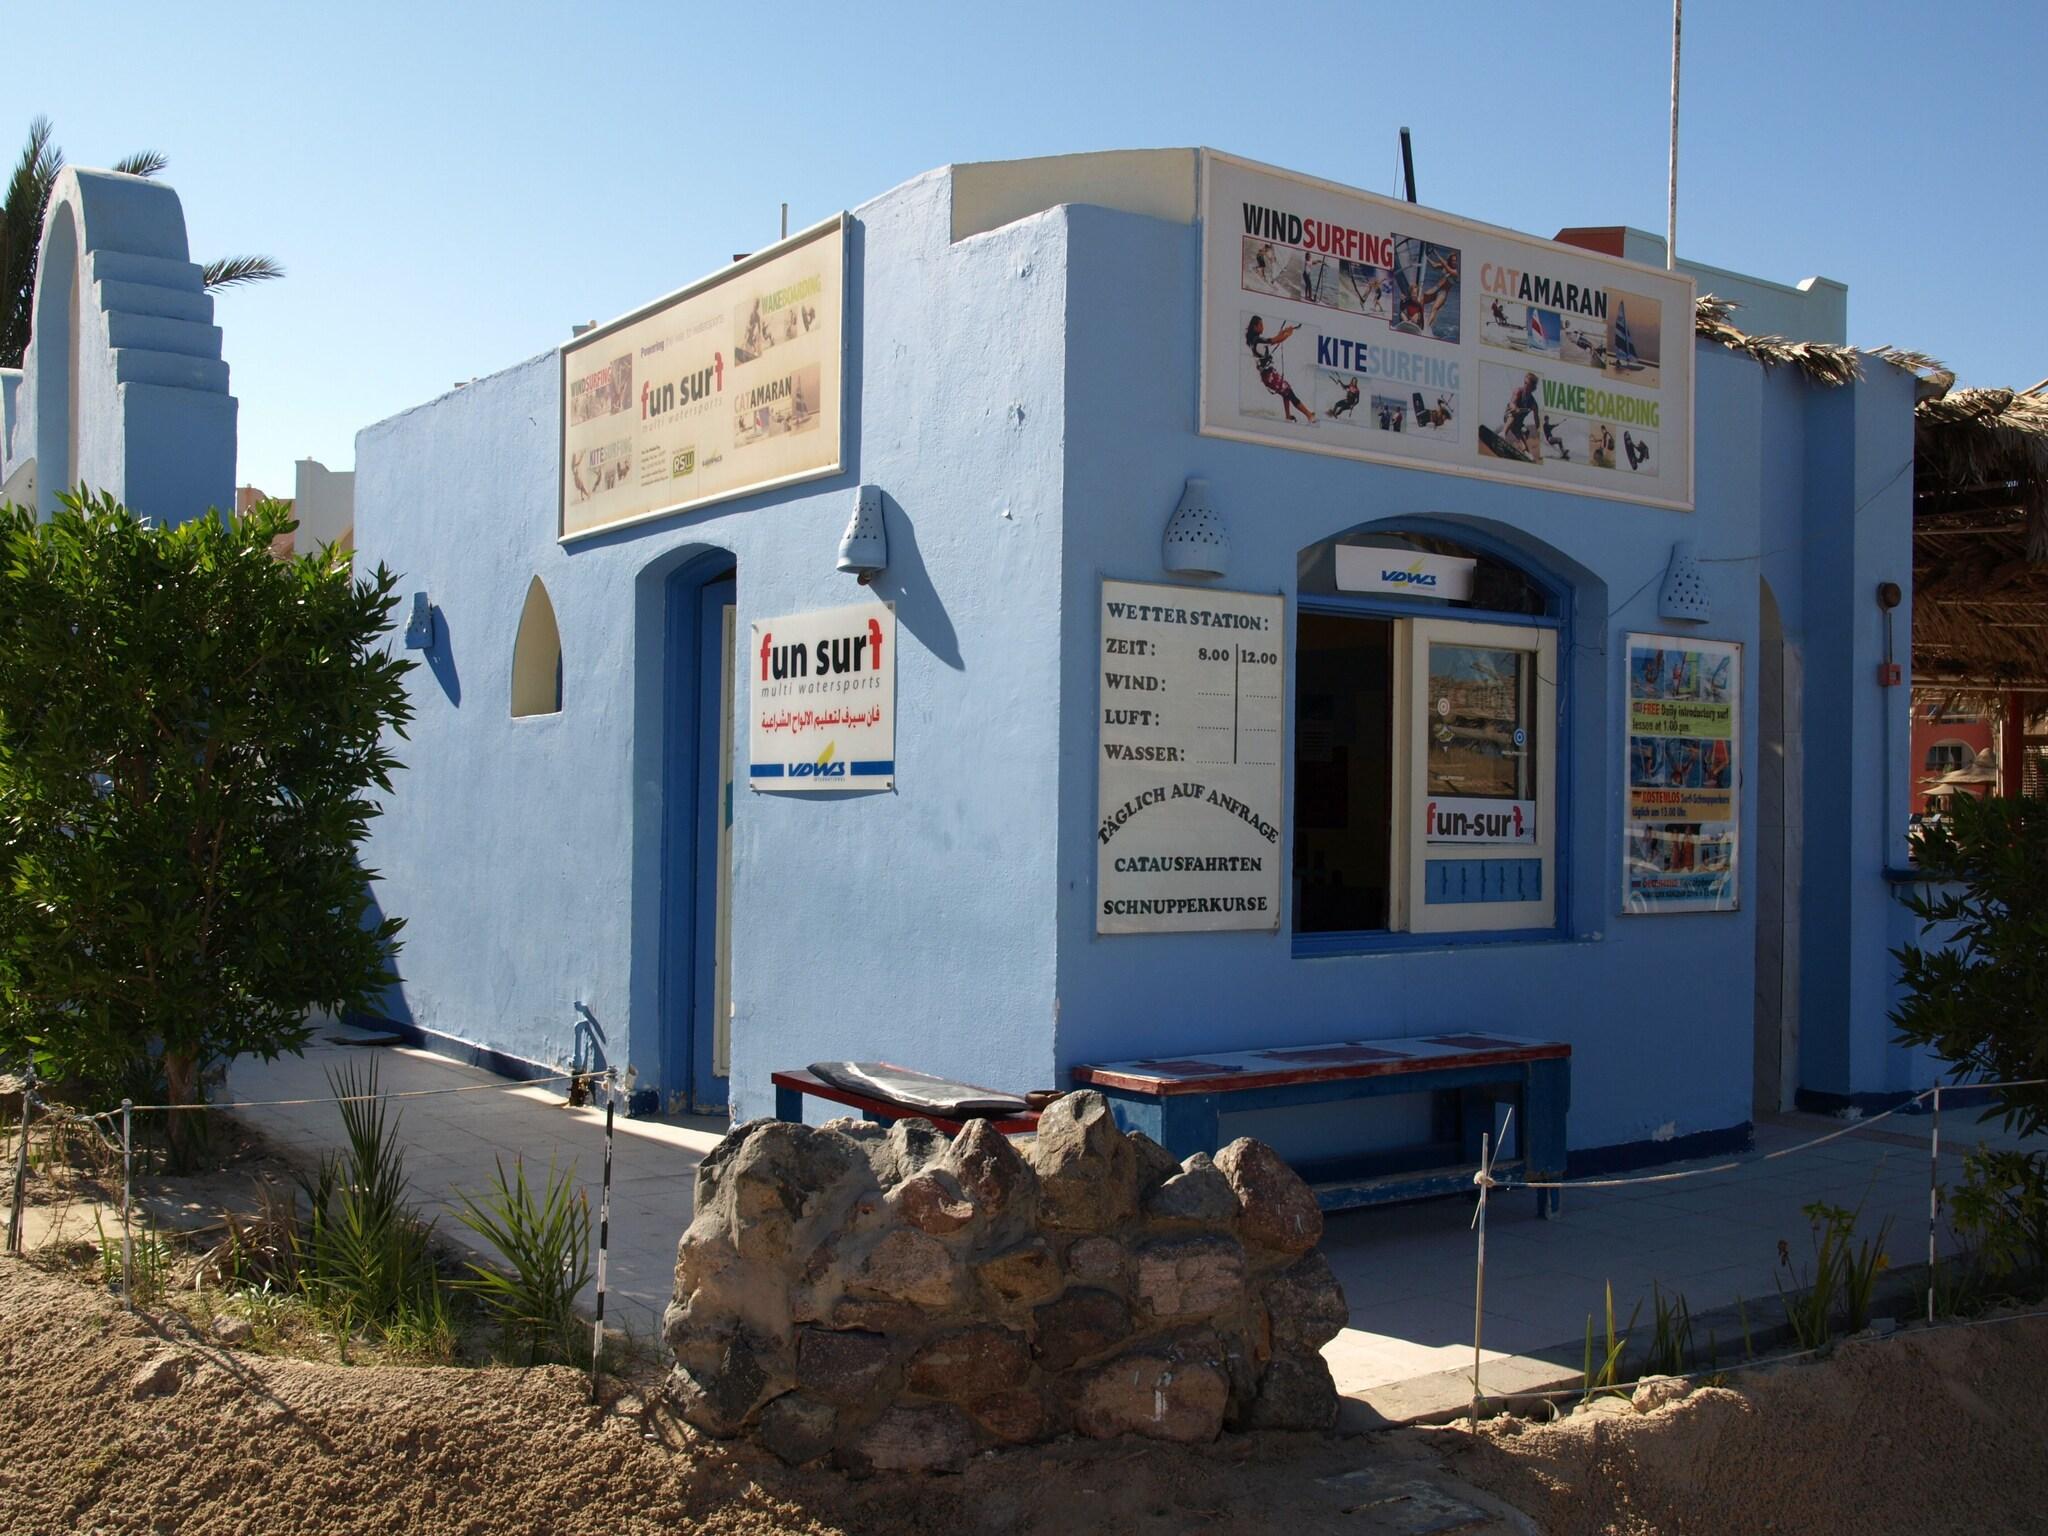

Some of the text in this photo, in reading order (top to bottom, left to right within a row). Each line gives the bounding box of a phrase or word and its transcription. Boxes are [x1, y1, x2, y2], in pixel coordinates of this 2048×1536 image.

[1243, 202, 1393, 268] WINDSURFING
[761, 273, 822, 315] WAKEBOARDING
[1480, 262, 1608, 320] CATAMARAN
[1317, 335, 1460, 390] KITESURFING
[570, 366, 612, 398] WINDSURFING
[641, 351, 724, 421] fun surf
[735, 375, 792, 415] CATAMARAN
[668, 396, 723, 424] watersports
[1542, 379, 1660, 428] WAKEBOARDING
[1381, 570, 1437, 586] VDWS
[760, 618, 883, 681] fun surf
[1106, 638, 1278, 665] ZEIT: 8.00 12.00
[761, 676, 881, 698] multi watersports
[1105, 672, 1166, 692] WIND:
[1104, 709, 1160, 726] LUFT:
[1632, 718, 1653, 731] lesson
[1642, 703, 1660, 716] FREE
[1661, 704, 1677, 720] Daily
[1104, 744, 1185, 762] WASSER:
[788, 761, 846, 777] VDWS
[1642, 790, 1680, 804] KOSTENLOS
[1098, 782, 1279, 845] TÄGLICH AUF ANFRAGE
[1114, 856, 1263, 872] CATAUSFAHRTEN
[1103, 896, 1268, 915] SCHNUPPERKURSE
